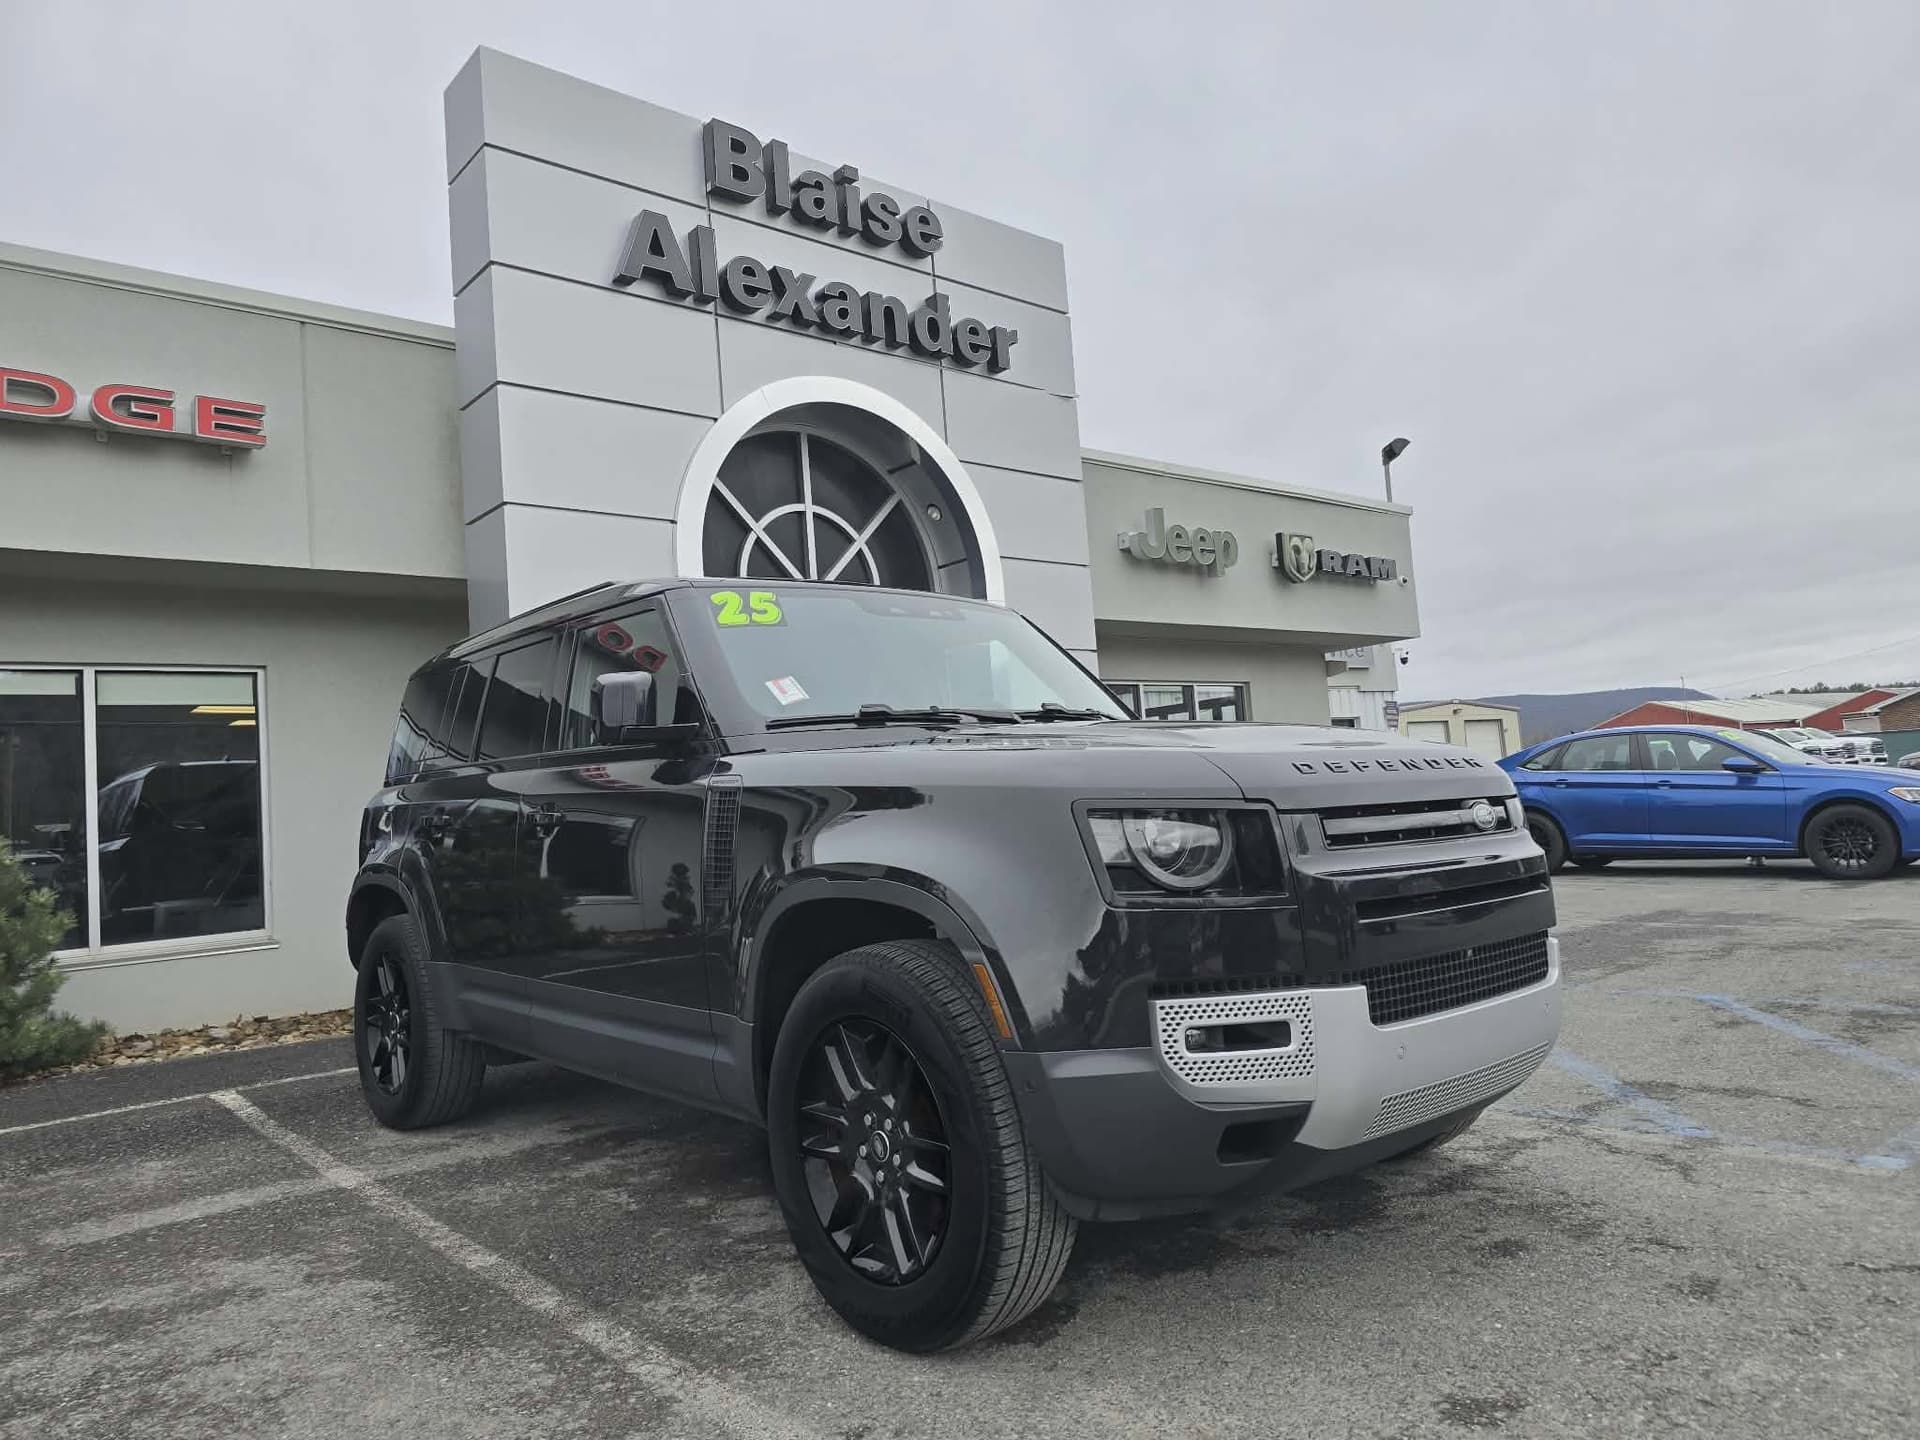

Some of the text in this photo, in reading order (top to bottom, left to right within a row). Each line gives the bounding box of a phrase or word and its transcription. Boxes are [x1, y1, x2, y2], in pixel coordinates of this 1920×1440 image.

[703, 117, 943, 258] Blaise
[612, 209, 1018, 374] Alexander
[1128, 507, 1238, 577] Jeep
[1316, 549, 1397, 580] RAM
[710, 591, 783, 626] 25
[1291, 757, 1484, 775] DEFENDER
